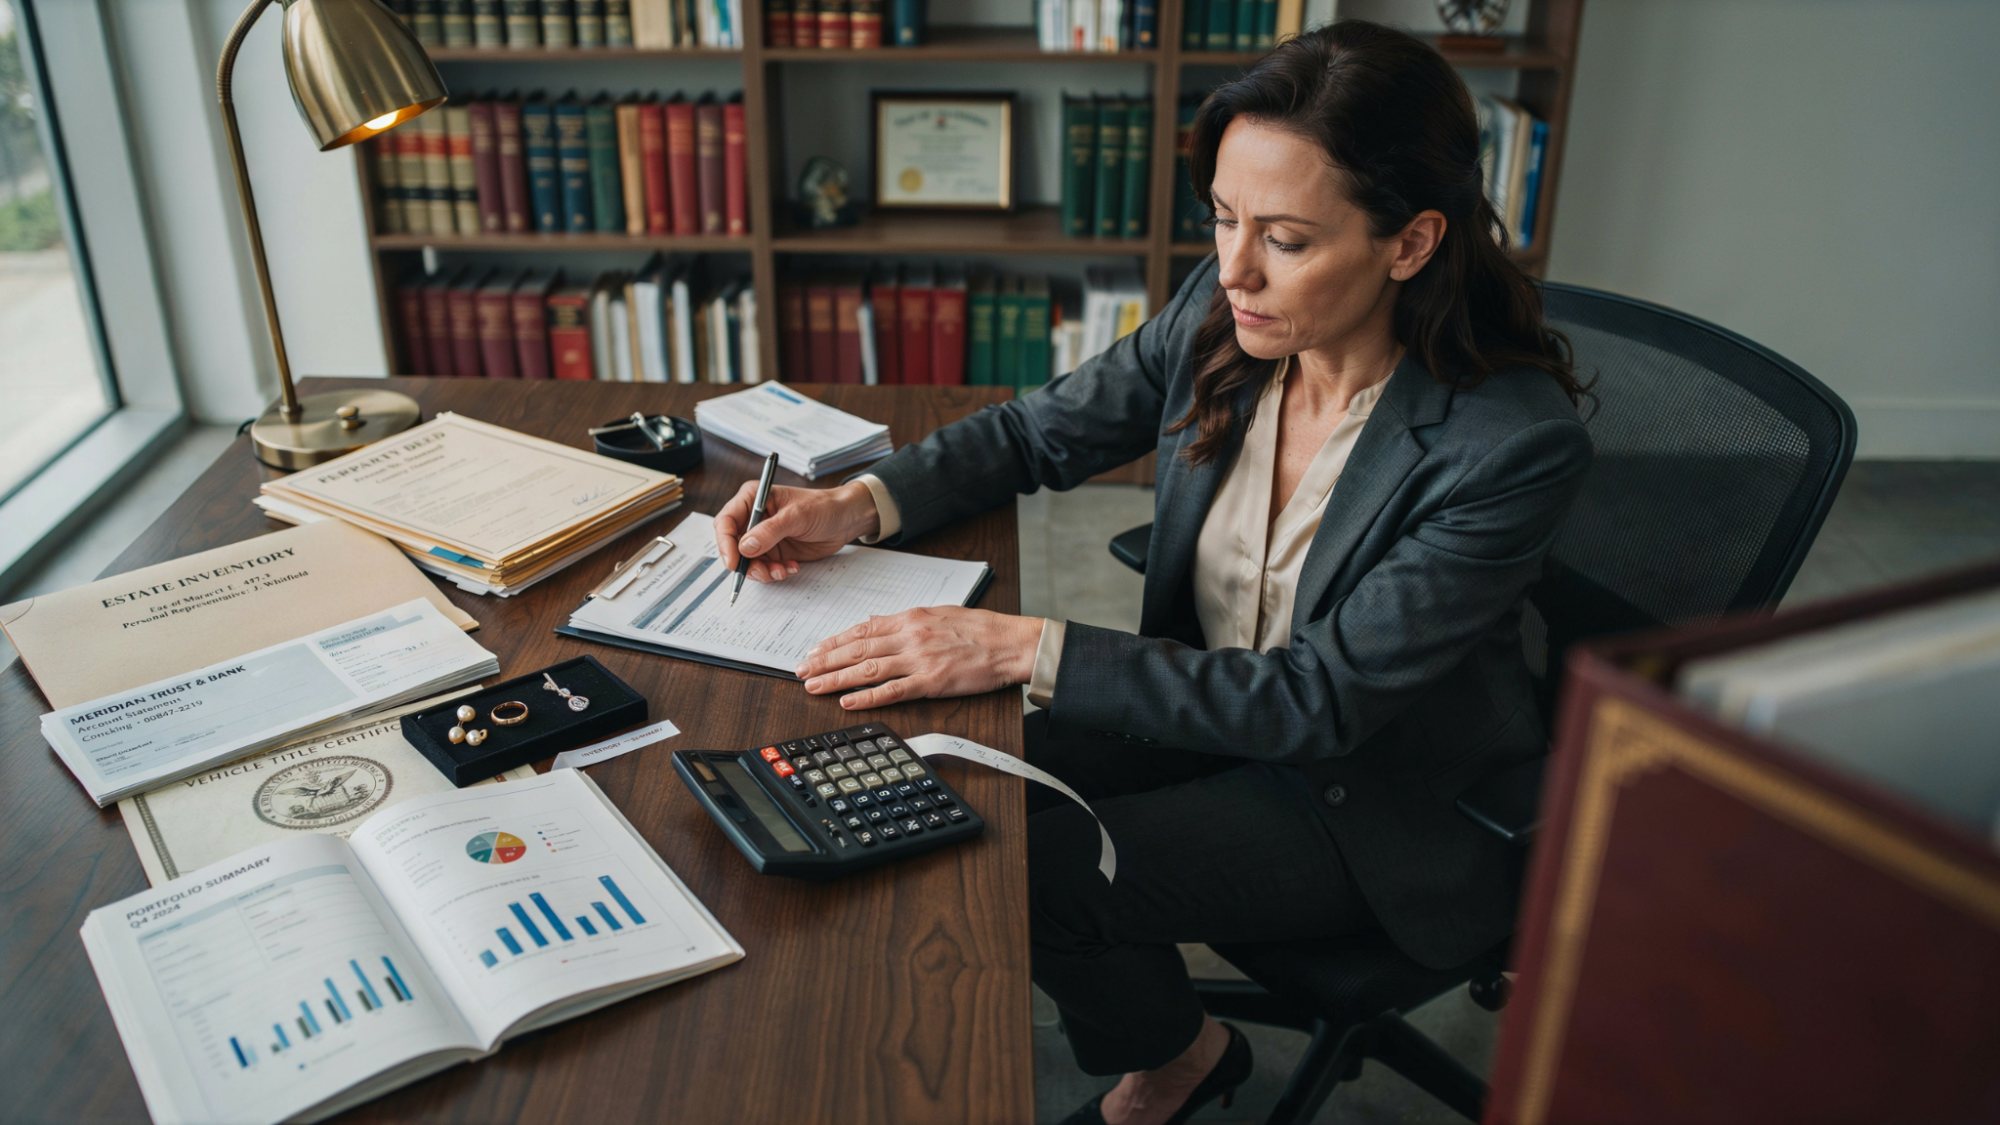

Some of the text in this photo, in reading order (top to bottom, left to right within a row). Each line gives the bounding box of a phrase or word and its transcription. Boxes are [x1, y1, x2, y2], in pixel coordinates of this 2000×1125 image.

[101, 582, 175, 609] ESTATE
[123, 611, 169, 629] Personal
[263, 570, 309, 587] Whitfield
[70, 665, 246, 725] MERIDIAN TRUST & BANK
[78, 715, 123, 734] Account
[184, 761, 263, 788] VEHICLE
[271, 745, 317, 765] TITLE
[126, 885, 202, 920] PORTFOLIO
[205, 856, 271, 888] SUMMARY
[130, 903, 181, 929] Q4 2024
